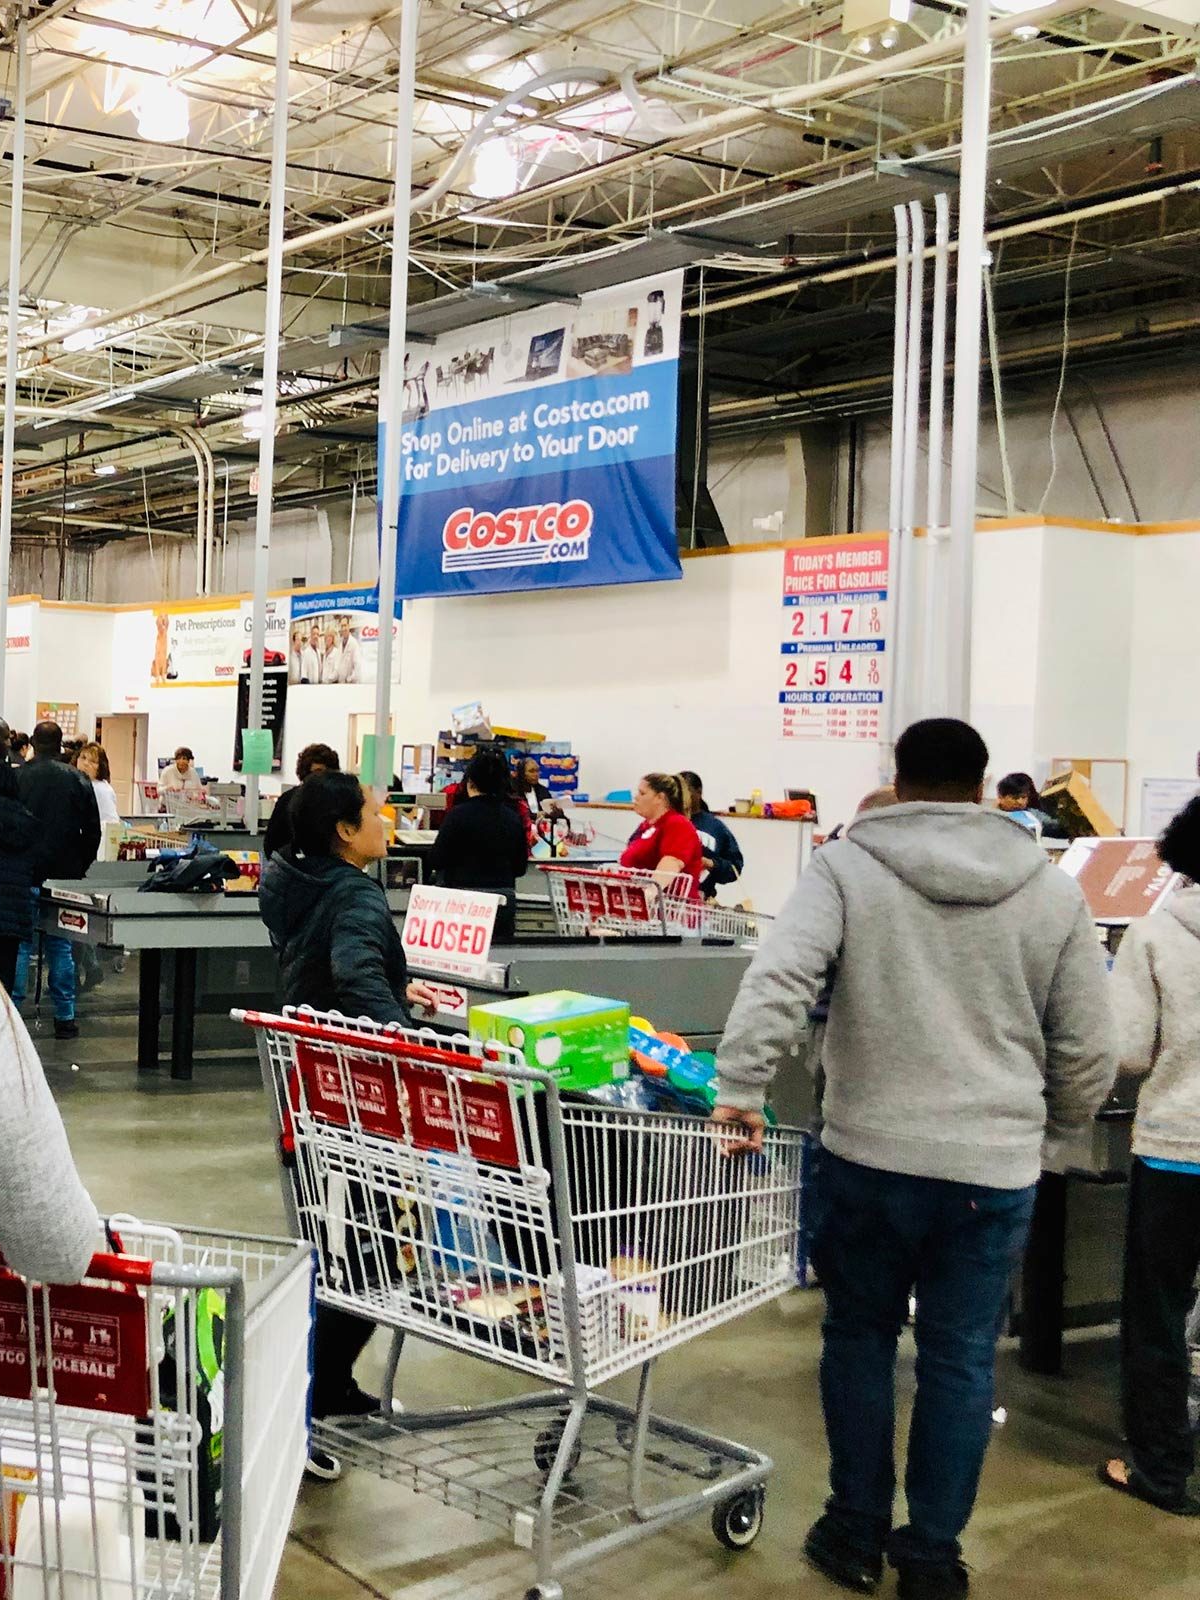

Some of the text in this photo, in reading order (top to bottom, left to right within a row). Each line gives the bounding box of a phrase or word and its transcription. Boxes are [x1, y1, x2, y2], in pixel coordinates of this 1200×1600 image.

[401, 390, 650, 456] Shop Online at Costco.com
[404, 424, 639, 480] for Delivery to Your Door
[444, 500, 592, 550] COSTCO
[544, 540, 585, 560] .COM
[793, 549, 882, 572] TODAY'S MEMBER
[785, 570, 888, 592] PRICE FOR GASOLINE
[337, 597, 365, 607] SERVICES
[800, 595, 835, 606] REGULAR
[175, 617, 236, 632] Pet Prescriptions
[798, 642, 833, 653] PREMIUM
[785, 692, 879, 702] HOURS OF OPERATION
[445, 899, 465, 914] this
[468, 902, 493, 918] lane
[405, 916, 487, 955] CLOSED
